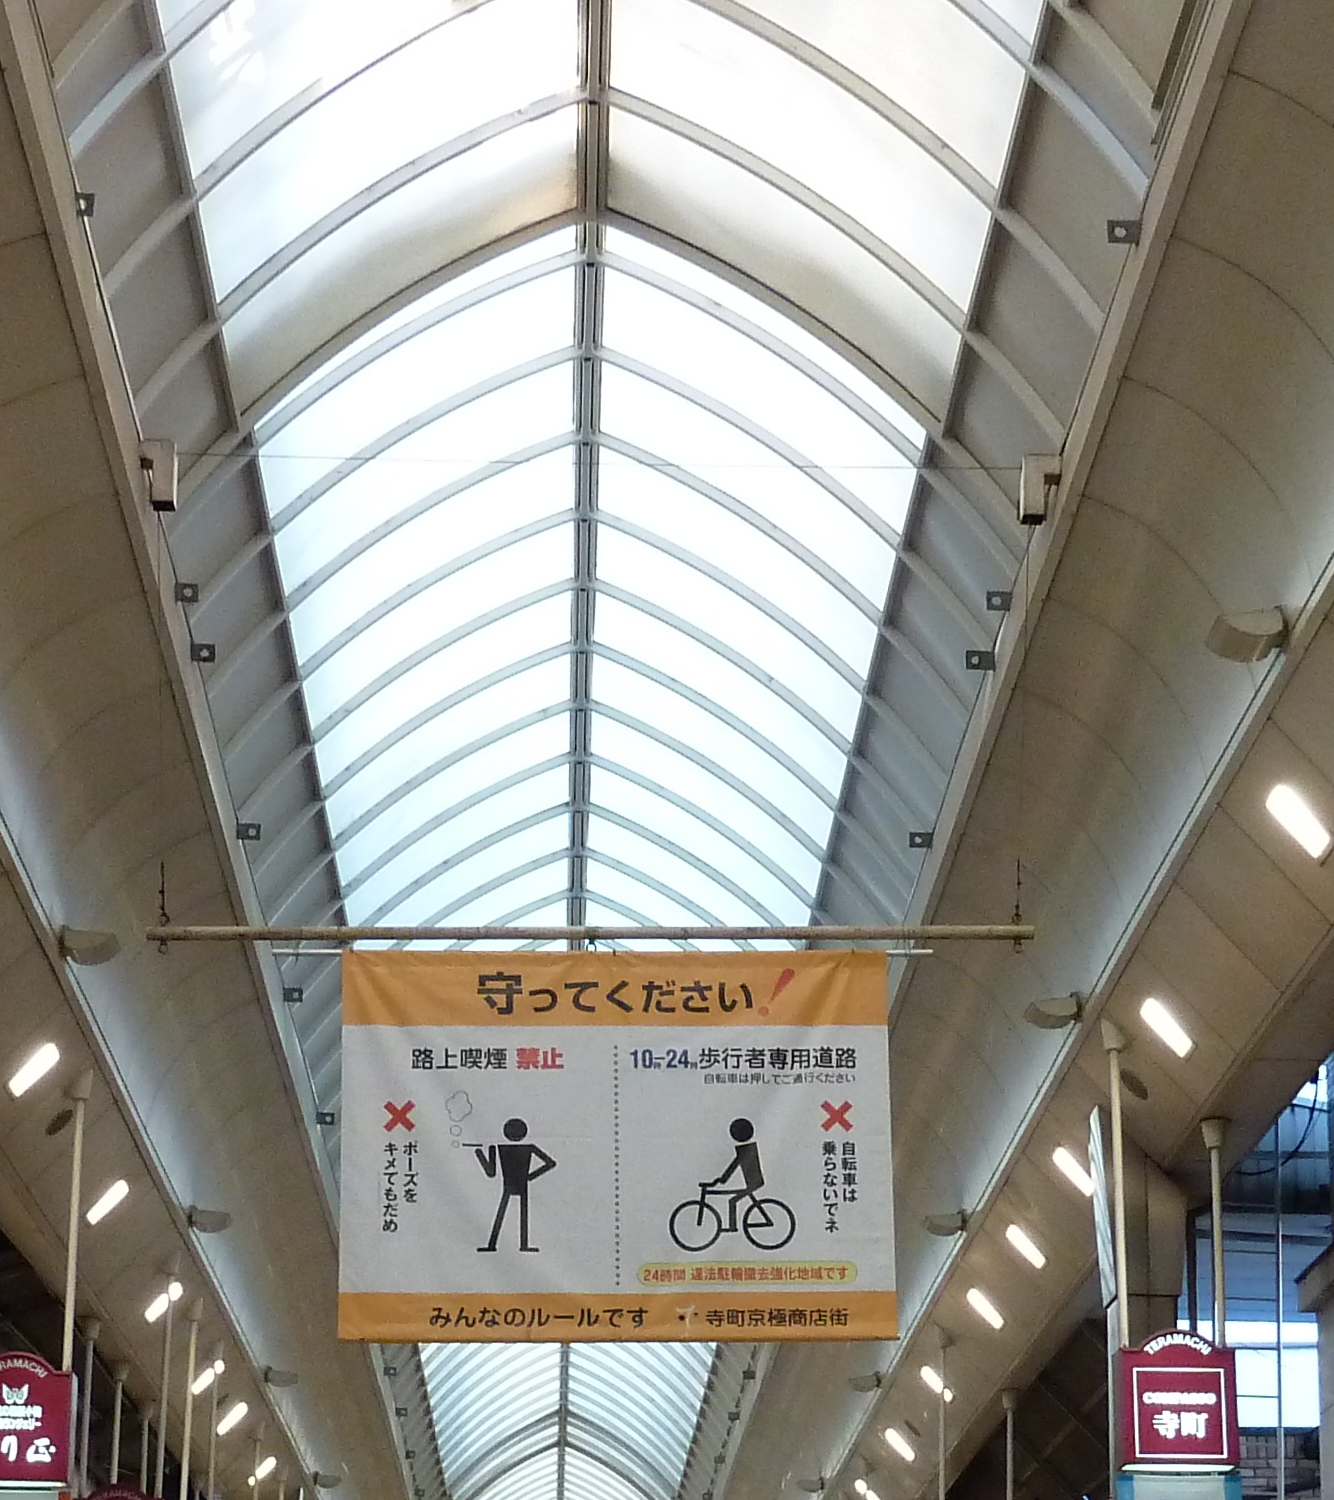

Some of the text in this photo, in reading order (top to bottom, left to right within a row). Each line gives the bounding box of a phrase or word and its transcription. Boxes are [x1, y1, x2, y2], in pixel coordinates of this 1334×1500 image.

[515, 1046, 565, 1071] 禁止
[703, 1072, 856, 1086] 自転車は押してご通行ください
[402, 1140, 420, 1205] ポーズを
[840, 1140, 858, 1203] 自転車は
[381, 1142, 400, 1234] キメてもだめ
[821, 1140, 841, 1234] 乗らないでネ
[428, 1305, 850, 1329] みんなのルールです 寺町京極商店街
[1143, 1332, 1213, 1356] TERAMACHI
[1151, 1411, 1208, 1440] 寺町
